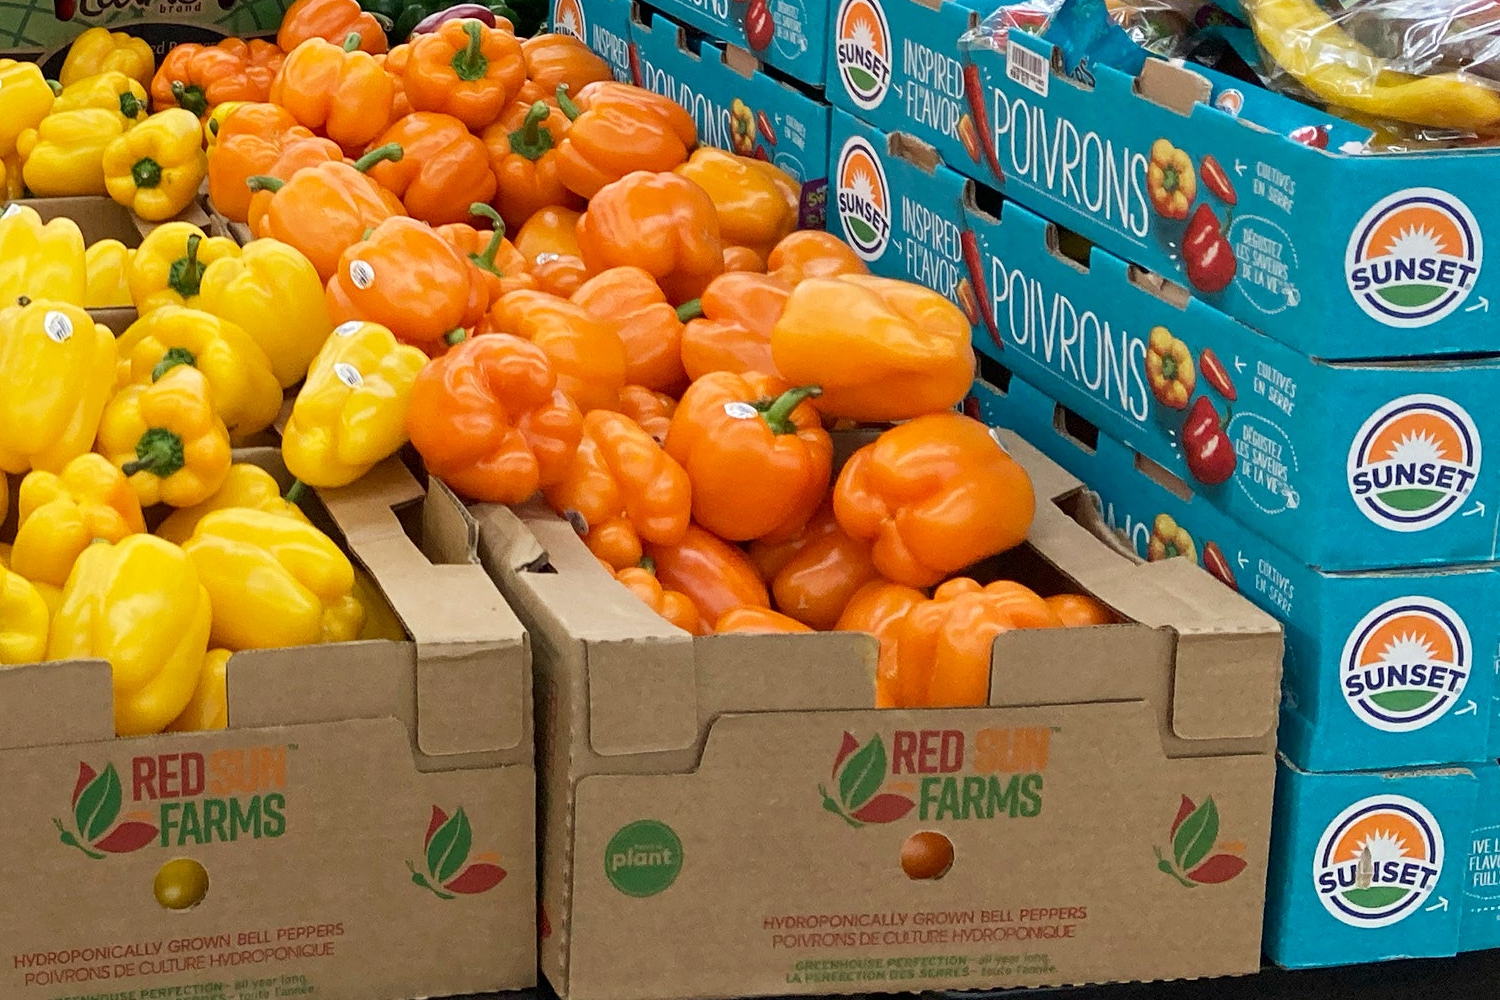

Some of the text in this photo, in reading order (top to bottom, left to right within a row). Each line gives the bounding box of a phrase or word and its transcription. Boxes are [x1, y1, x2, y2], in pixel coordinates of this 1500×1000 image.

[159, 2, 201, 13] brand
[592, 23, 630, 69] INSPIRED
[838, 43, 890, 85] SUNSET
[904, 38, 965, 99] INSPIRED
[907, 81, 960, 142] FLAVOR
[993, 88, 1149, 239] POIVRONS
[839, 192, 889, 245] SUNSET
[901, 195, 963, 263] INSPIRED
[905, 238, 960, 303] FLAVOR
[1351, 256, 1478, 290] SUNSET
[992, 255, 1149, 422] POIVRONS
[1352, 463, 1475, 496] SUNSET
[1346, 663, 1467, 698] SUNSET
[132, 745, 287, 801] RED SUN
[893, 726, 1050, 776] RED SUN
[159, 793, 287, 848] FARMS
[918, 773, 1043, 821] FARMS
[611, 845, 672, 871] plant
[763, 906, 1088, 931] HYDROPONICALLY GROWN BELL PEPPERS
[772, 924, 1077, 949] POIVRONS DE CULTURE HYDROPONIQUE
[14, 922, 345, 969] HYDROPONICALLY GROWN BELL PEPPERS
[25, 965, 111, 987] POIVRONS
[114, 962, 136, 979] DE
[139, 955, 206, 977] CULTURE
[210, 941, 336, 968] HYDROPONIQUE
